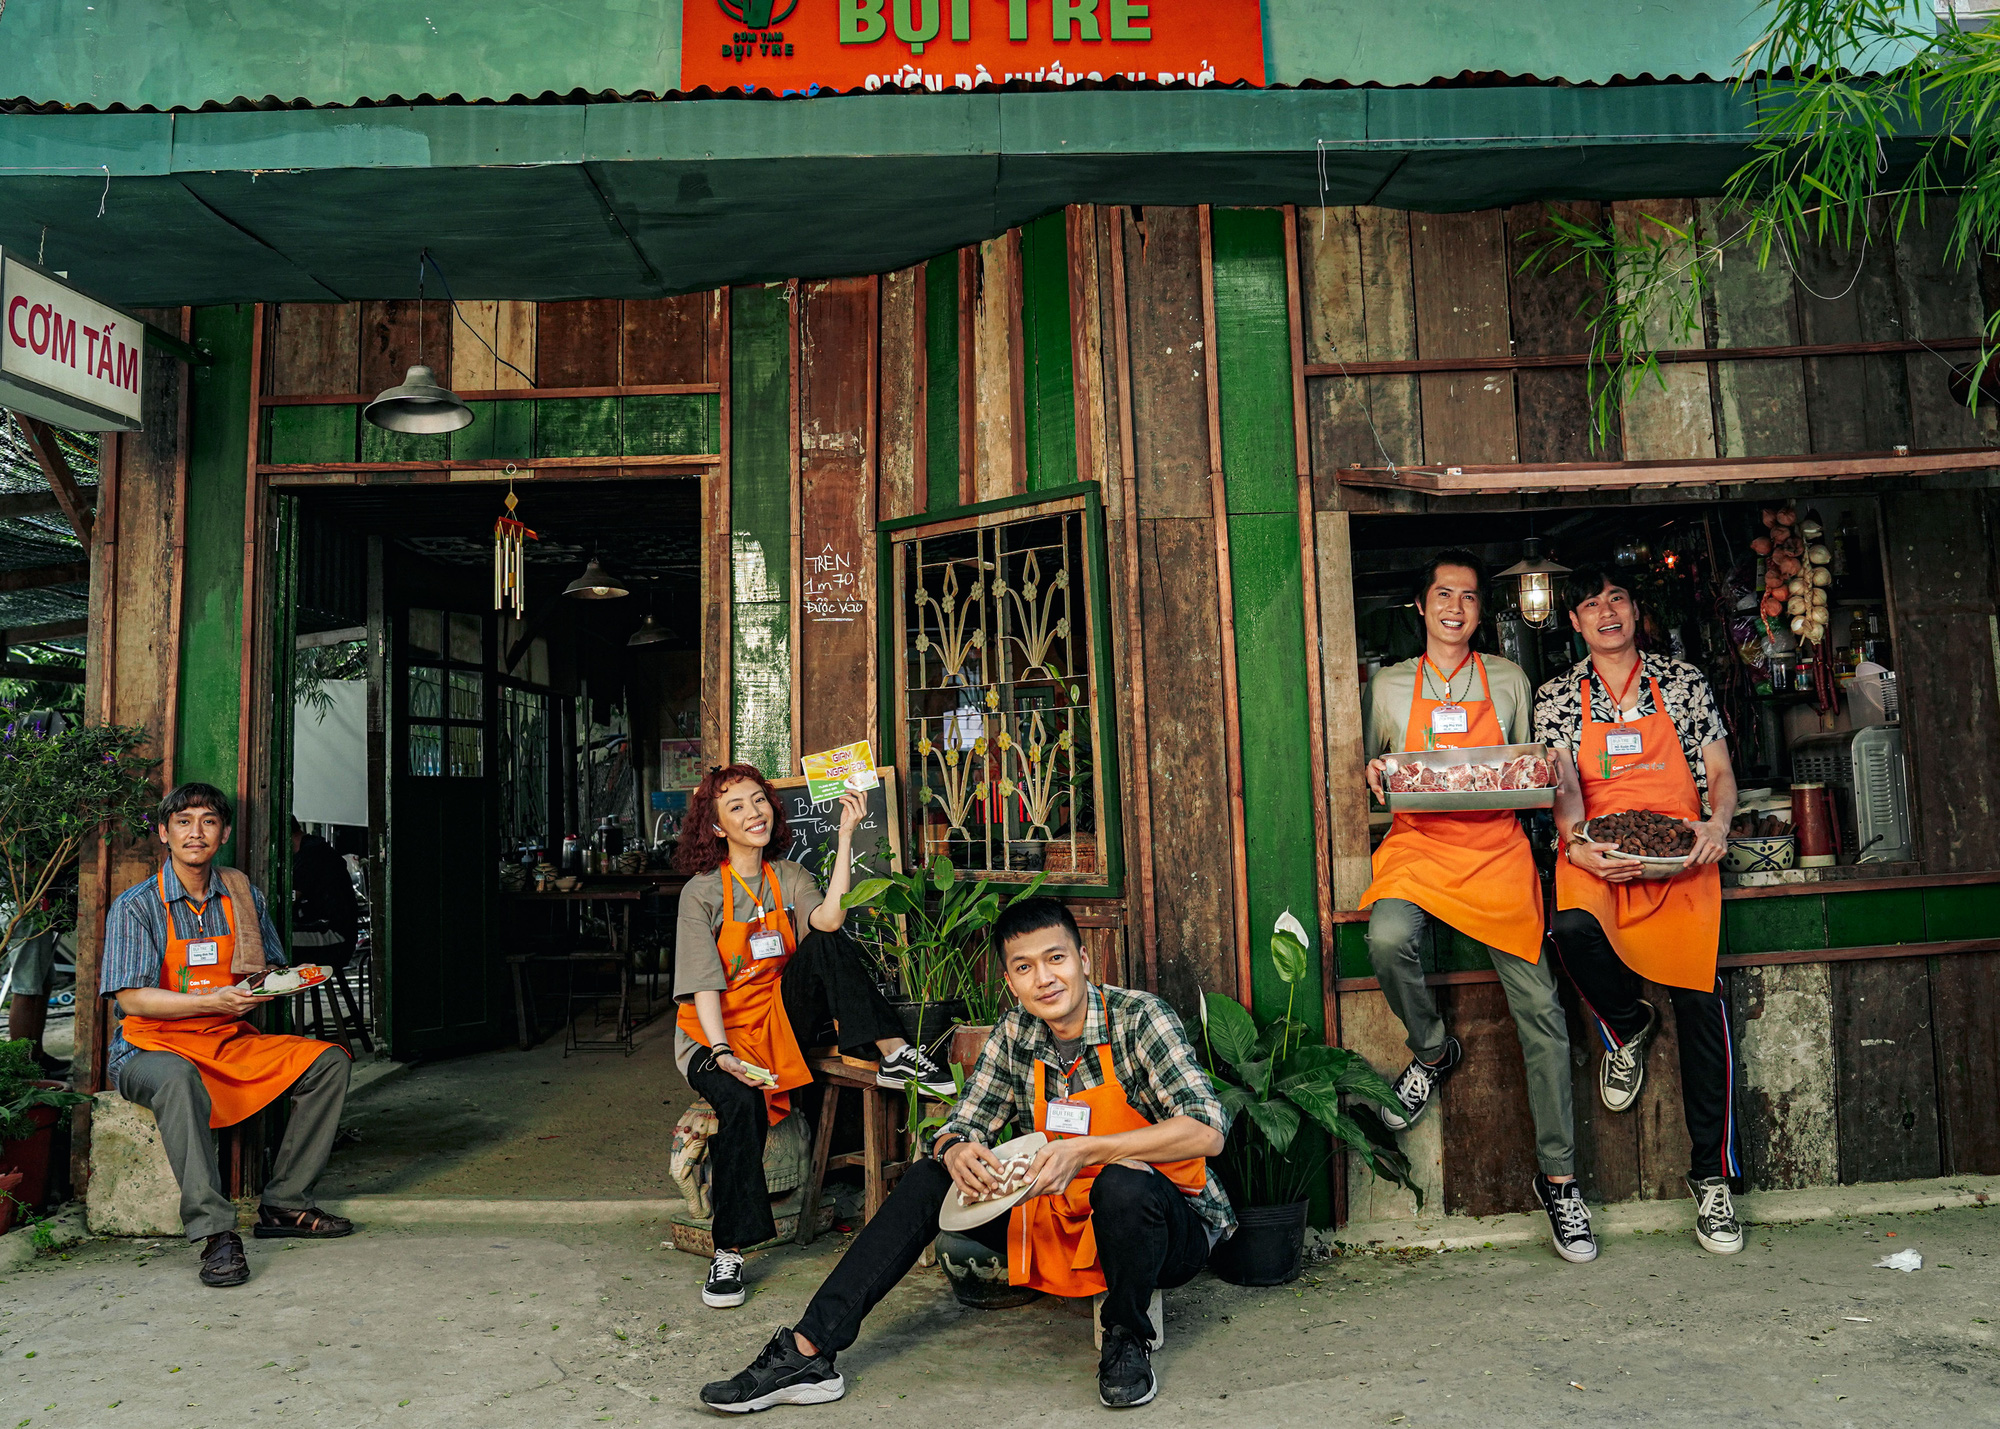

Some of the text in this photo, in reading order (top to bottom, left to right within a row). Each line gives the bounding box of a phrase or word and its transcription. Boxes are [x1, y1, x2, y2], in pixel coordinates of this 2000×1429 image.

[840, 0, 1151, 55] BỤI TRE
[722, 43, 793, 62] BỤI TRE
[8, 295, 138, 395] CƠM TẤM
[805, 543, 850, 574] TRÊN
[851, 759, 867, 772] 20%
